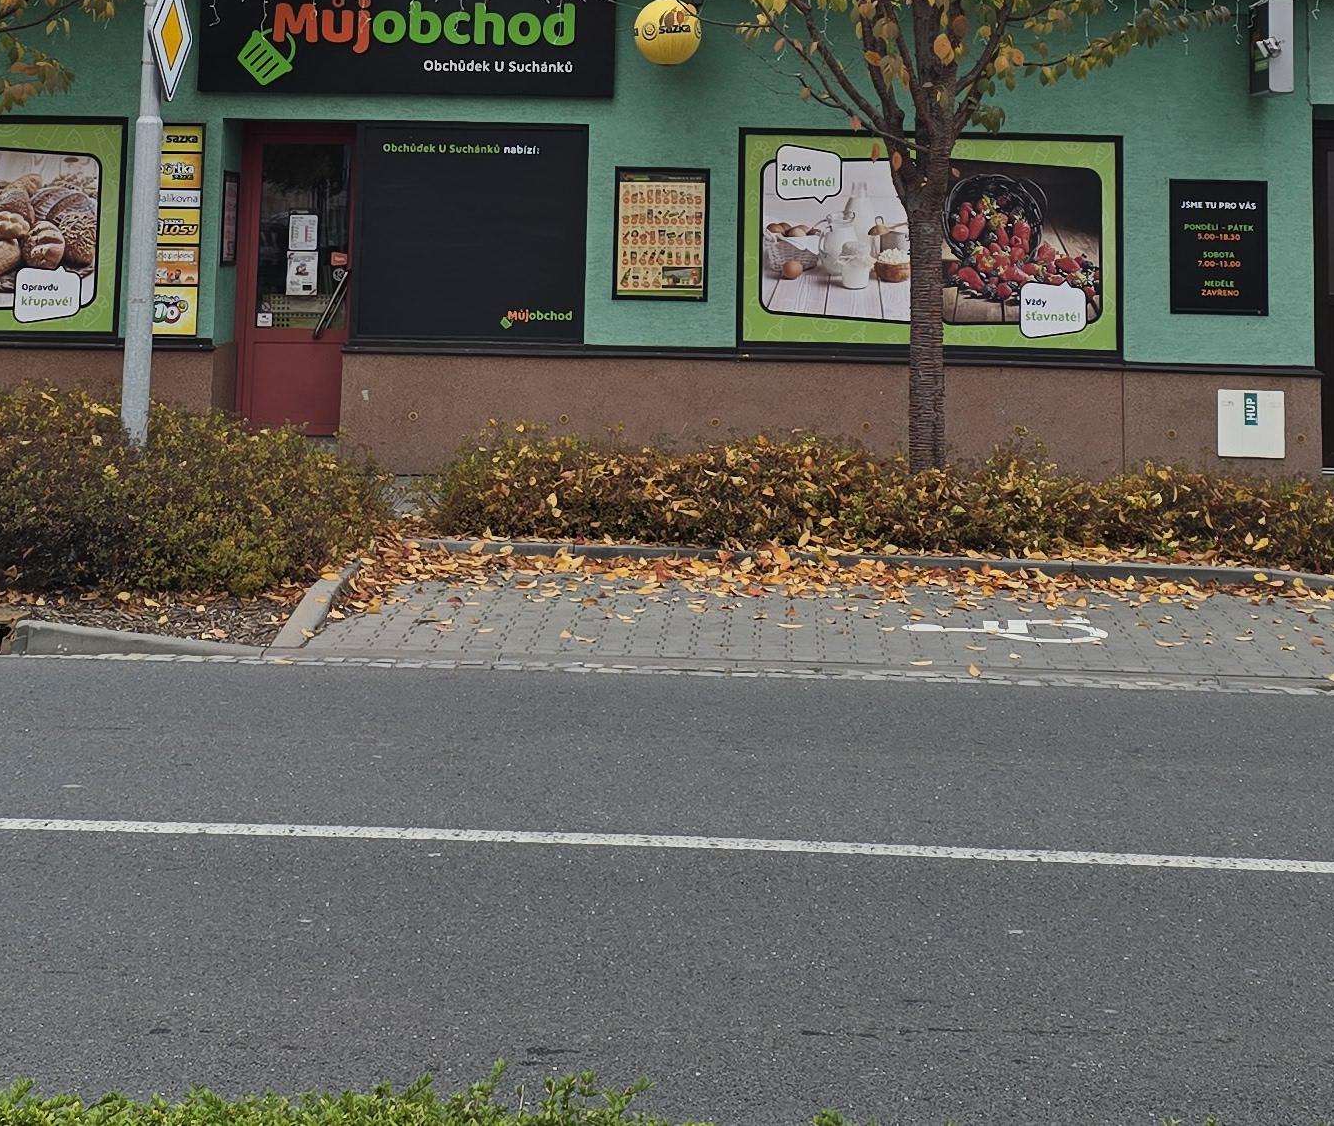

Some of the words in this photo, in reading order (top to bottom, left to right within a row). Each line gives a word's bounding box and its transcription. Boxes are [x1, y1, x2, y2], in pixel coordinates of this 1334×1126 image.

[423, 60, 490, 72] Obchůdek
[494, 61, 504, 72] U
[509, 61, 573, 73] Suchánků
[166, 135, 198, 143] sazka
[383, 143, 435, 153] Obchůdek
[438, 144, 446, 153] U
[449, 144, 500, 154] Suchánků
[504, 145, 540, 154] nabízí:
[782, 178, 788, 186] a
[792, 176, 835, 186] chutné!
[1181, 201, 1203, 209] JSME
[1219, 202, 1237, 210] PRO
[1239, 201, 1257, 210] VÁS
[1184, 223, 1219, 231] PONDĚLÍ
[1227, 224, 1254, 232] PÁTEK
[22, 284, 58, 292] Opravdu
[1201, 289, 1239, 297] ZAVŘENO
[21, 296, 72, 308] křupavé!
[1025, 298, 1047, 307] Vždy
[507, 308, 573, 323] Můjobchod
[1025, 311, 1081, 322] šťavnaté!
[1246, 398, 1256, 420] HUP
